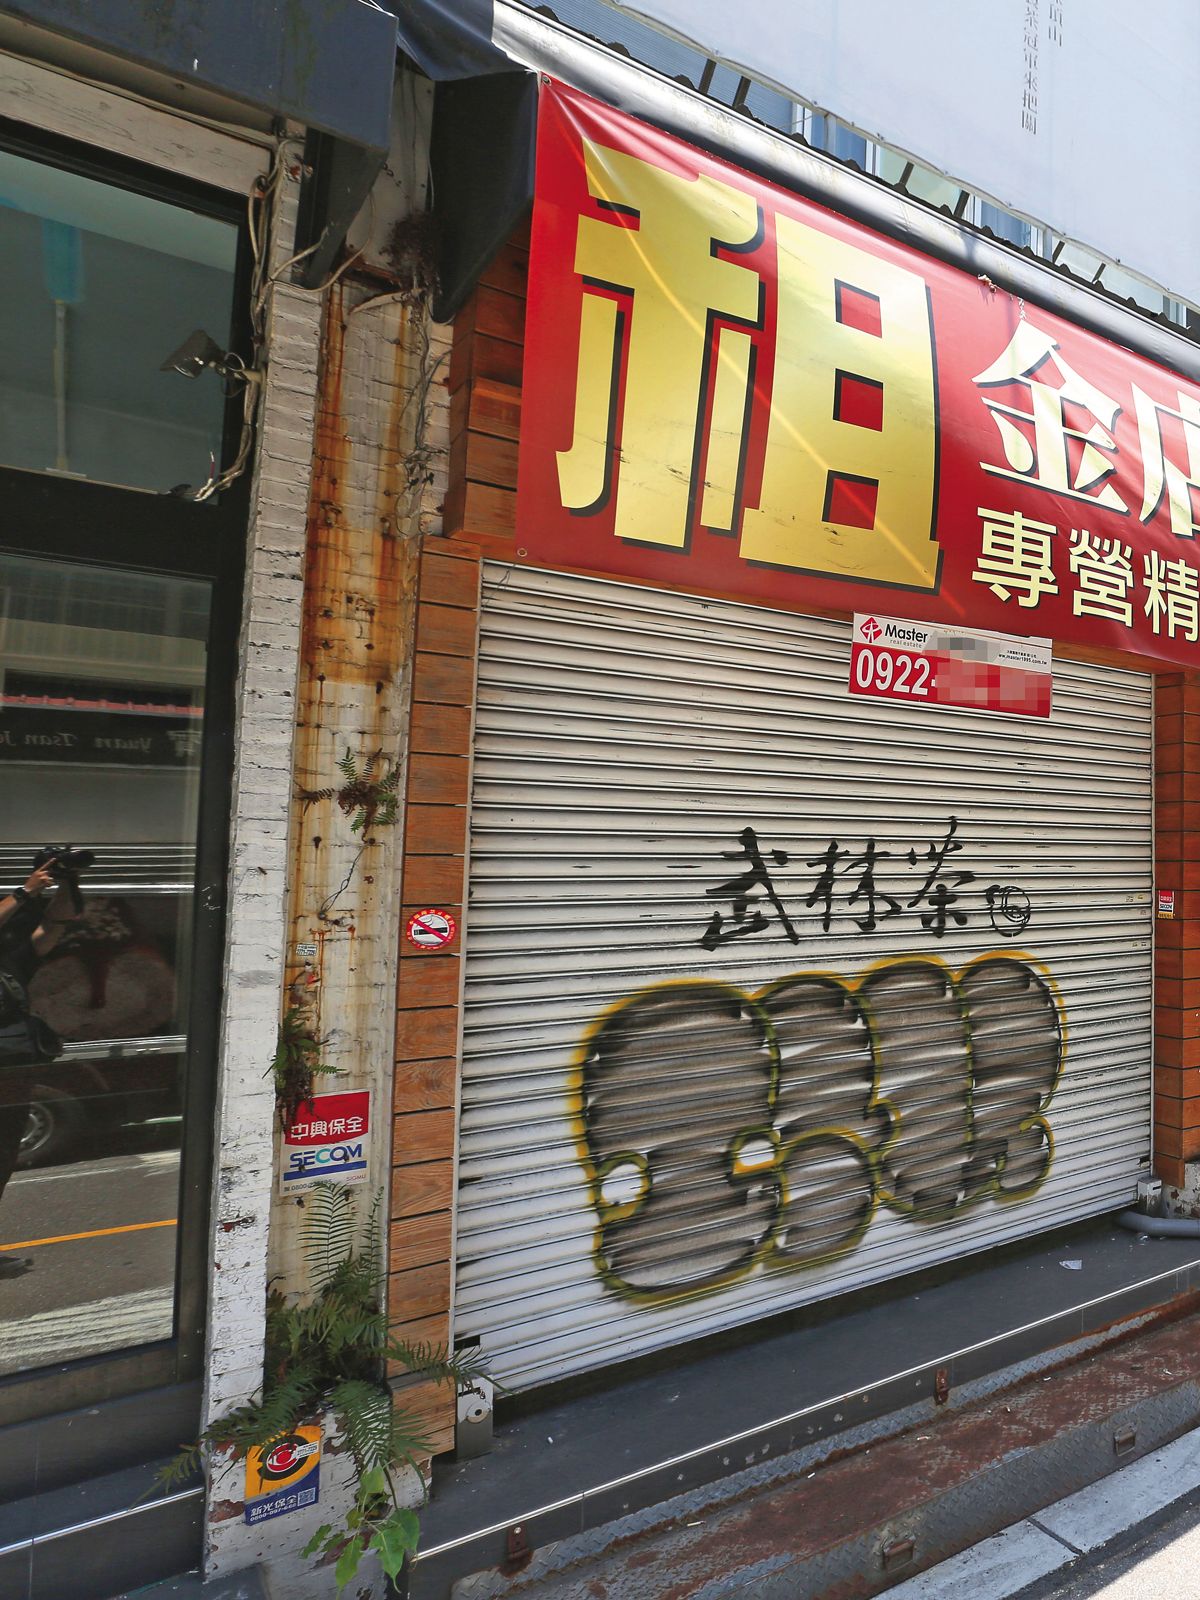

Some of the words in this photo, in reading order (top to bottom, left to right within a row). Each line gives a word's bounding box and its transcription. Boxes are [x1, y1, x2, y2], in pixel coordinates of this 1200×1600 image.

[555, 137, 942, 592] 租
[884, 624, 928, 643] Master
[903, 641, 922, 649] estate
[291, 1116, 364, 1140] 中興保全
[290, 1143, 362, 1169] SECOM
[250, 1495, 297, 1516] 新光保全
